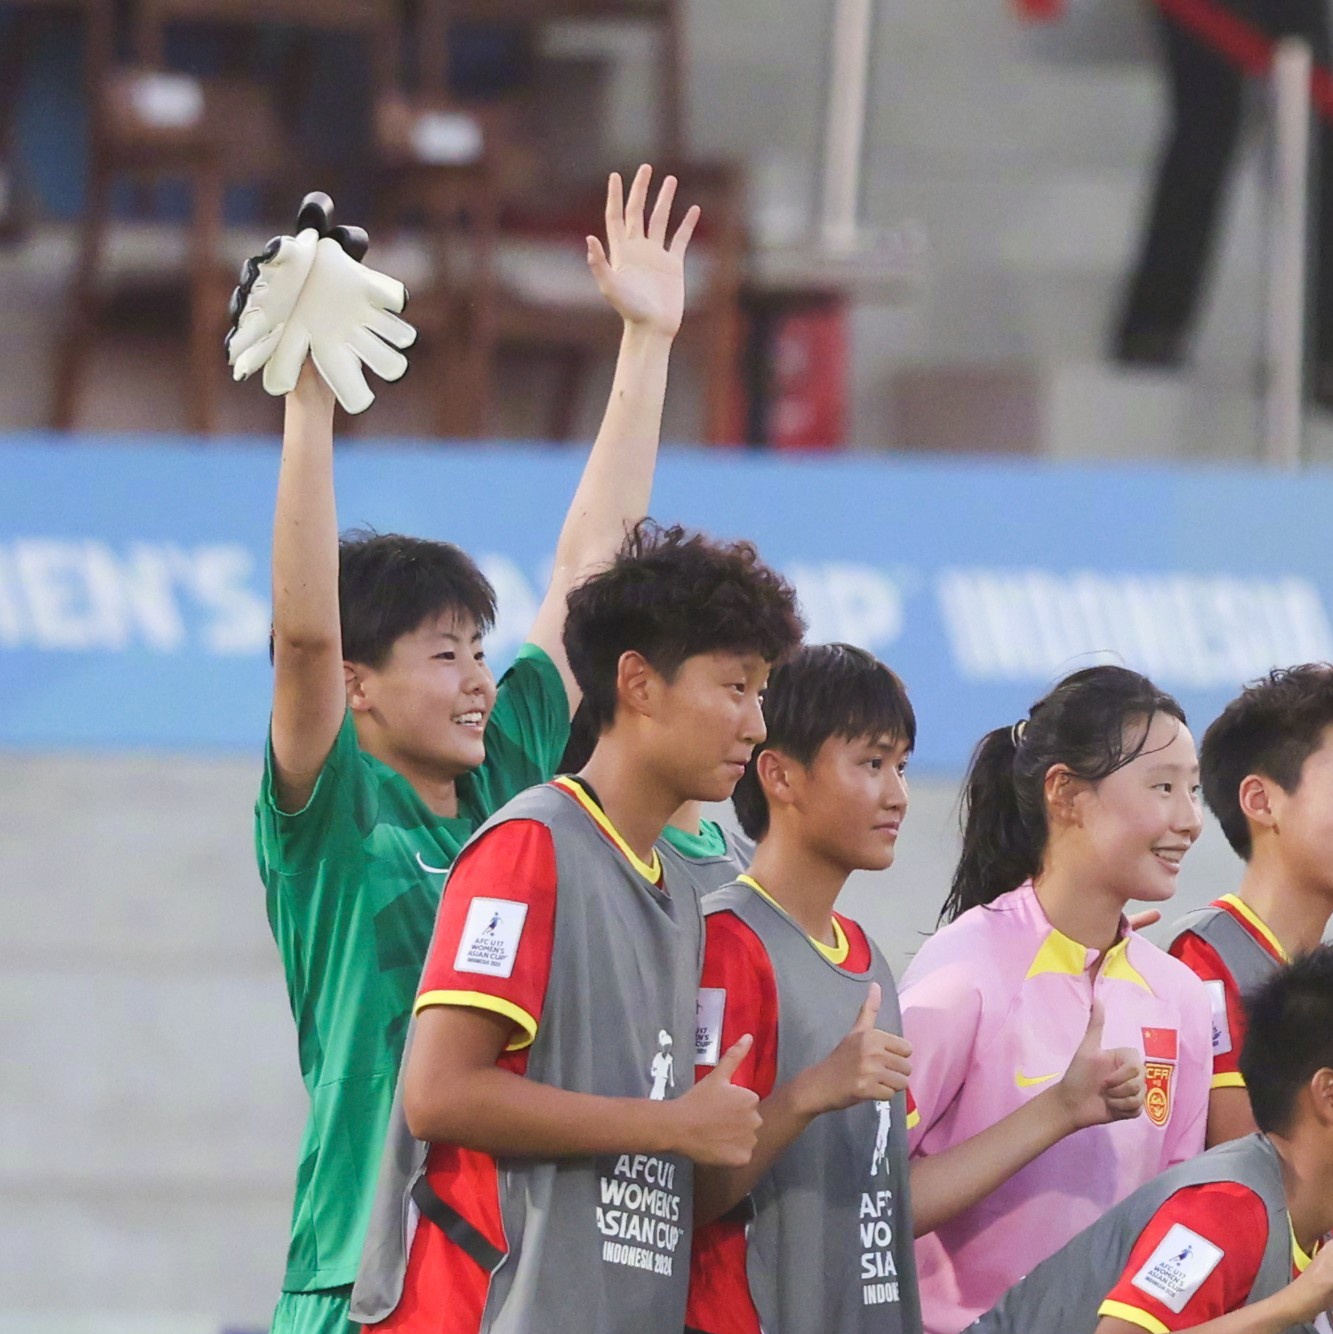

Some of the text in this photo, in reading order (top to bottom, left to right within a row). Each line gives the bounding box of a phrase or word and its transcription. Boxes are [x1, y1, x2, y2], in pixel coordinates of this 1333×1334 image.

[0, 541, 270, 652] EN'S
[1146, 1067, 1169, 1079] CFA
[614, 1154, 658, 1184] AFC
[600, 1176, 681, 1222] WOMEN'S
[595, 1206, 656, 1245] ASIAN
